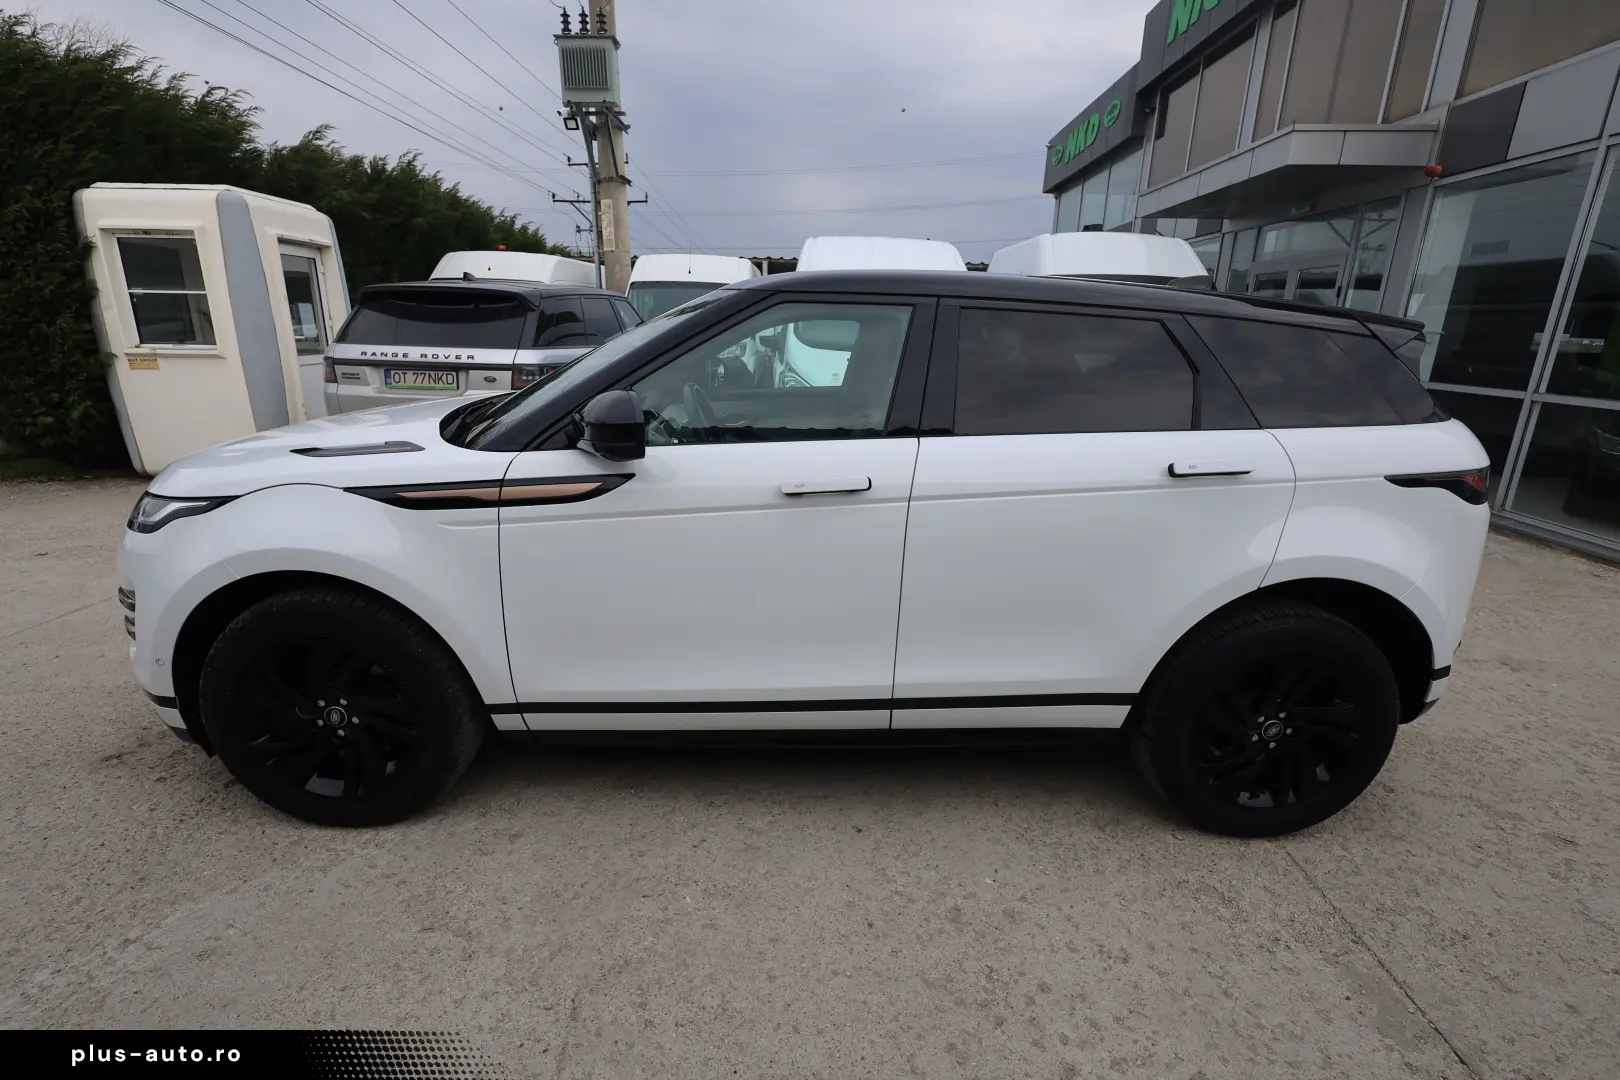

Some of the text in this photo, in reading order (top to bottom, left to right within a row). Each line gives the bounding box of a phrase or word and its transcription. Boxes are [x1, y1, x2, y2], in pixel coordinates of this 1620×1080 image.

[1065, 112, 1100, 164] NKD
[360, 351, 409, 359] RANGE
[393, 372, 454, 385] OT 77NKD
